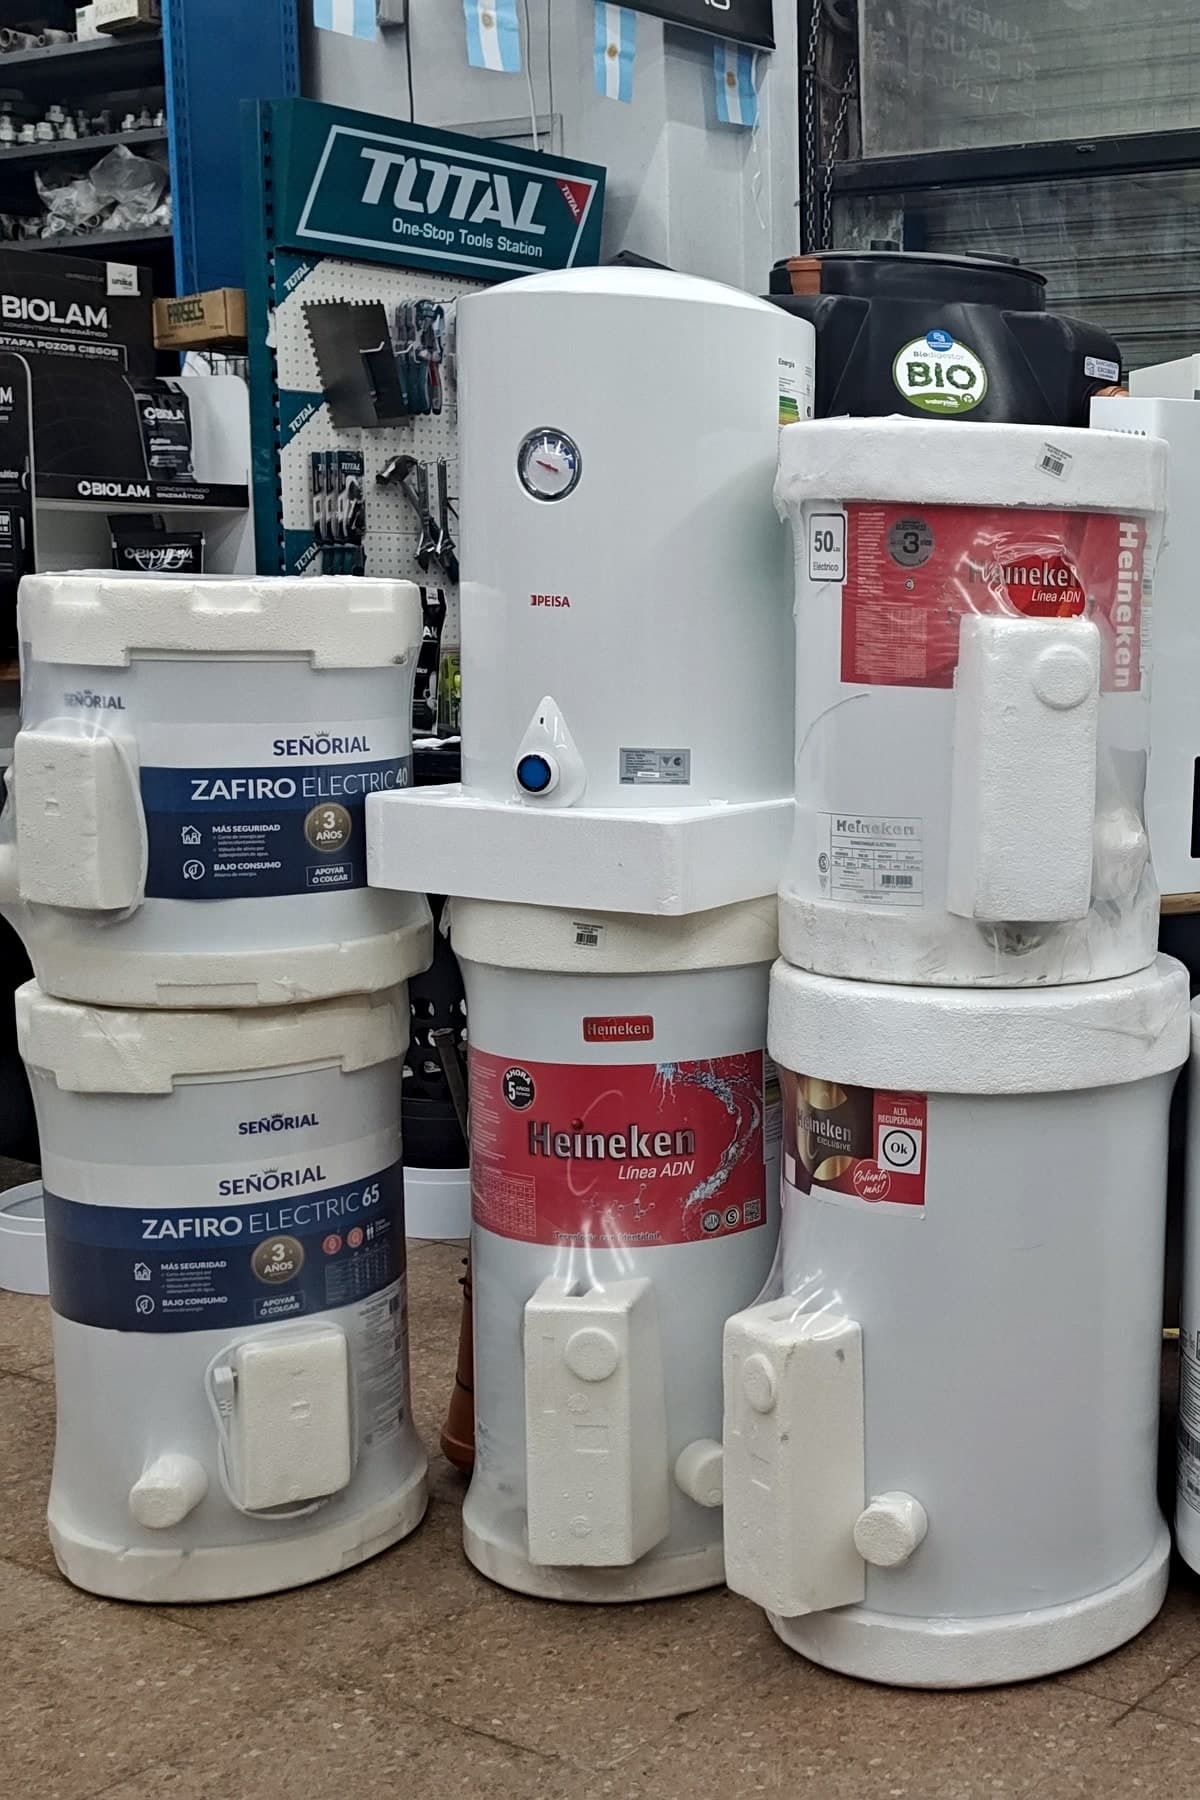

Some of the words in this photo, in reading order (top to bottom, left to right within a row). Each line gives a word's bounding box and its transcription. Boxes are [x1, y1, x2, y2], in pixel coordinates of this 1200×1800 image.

[360, 147, 546, 235] TOTAL
[561, 184, 581, 217] TOTAL
[392, 218, 454, 244] One-Stop
[459, 229, 493, 249] Tools
[497, 233, 542, 257] Station
[283, 262, 311, 291] TOTAL
[1, 295, 107, 328] BIOLAM
[37, 340, 76, 352] POZOS
[78, 344, 119, 357] CIEGOS
[906, 361, 977, 390] BIO
[288, 404, 315, 432] TOTAL
[341, 462, 361, 471] TOTAL
[93, 482, 150, 498] BIOLAM
[814, 531, 833, 552] 50
[902, 532, 920, 554] 3
[294, 542, 320, 571] TOTAL
[538, 595, 570, 608] PEISA
[1031, 589, 1057, 602] Línea
[1059, 591, 1082, 604] ADN
[1115, 522, 1139, 687] Heineken
[273, 735, 370, 756] SEÑORIAL
[191, 778, 296, 800] ZAFIRO
[303, 770, 394, 798] ELECTRIC
[396, 768, 408, 786] 40
[212, 825, 231, 834] MÁS
[233, 824, 281, 833] SEGURIDAD
[323, 811, 335, 830] 3
[836, 819, 914, 835] Heineken
[316, 830, 343, 841] AÑOS
[214, 863, 237, 871] BAJO
[238, 861, 281, 870] CONSUMO
[315, 866, 344, 876] APOYAR
[320, 874, 348, 883] COLGAR
[587, 1022, 650, 1035] Heineken
[506, 1069, 531, 1085] AHORA
[508, 1081, 516, 1101] 5
[893, 1107, 907, 1116] ALTA
[238, 1113, 319, 1135] SEÑORIAL
[878, 1115, 923, 1126] RECUPERACIÓN
[528, 1119, 696, 1159] Heineken
[891, 1142, 907, 1154] Ok
[618, 1164, 656, 1180] Línea
[660, 1160, 695, 1178] ADN
[219, 1165, 326, 1196] SEÑORIAL
[141, 1216, 242, 1239] ZAFIRO
[250, 1192, 359, 1234] ELECTRIC
[362, 1183, 380, 1207] 65
[272, 1244, 285, 1261] 3
[180, 1261, 227, 1270] SEGURIDAD
[264, 1260, 293, 1274] AÑOS
[162, 1299, 183, 1307] BAJO
[185, 1296, 228, 1306] CONSUMO
[263, 1296, 295, 1307] APOYAR
[268, 1303, 299, 1315] COLGAR
